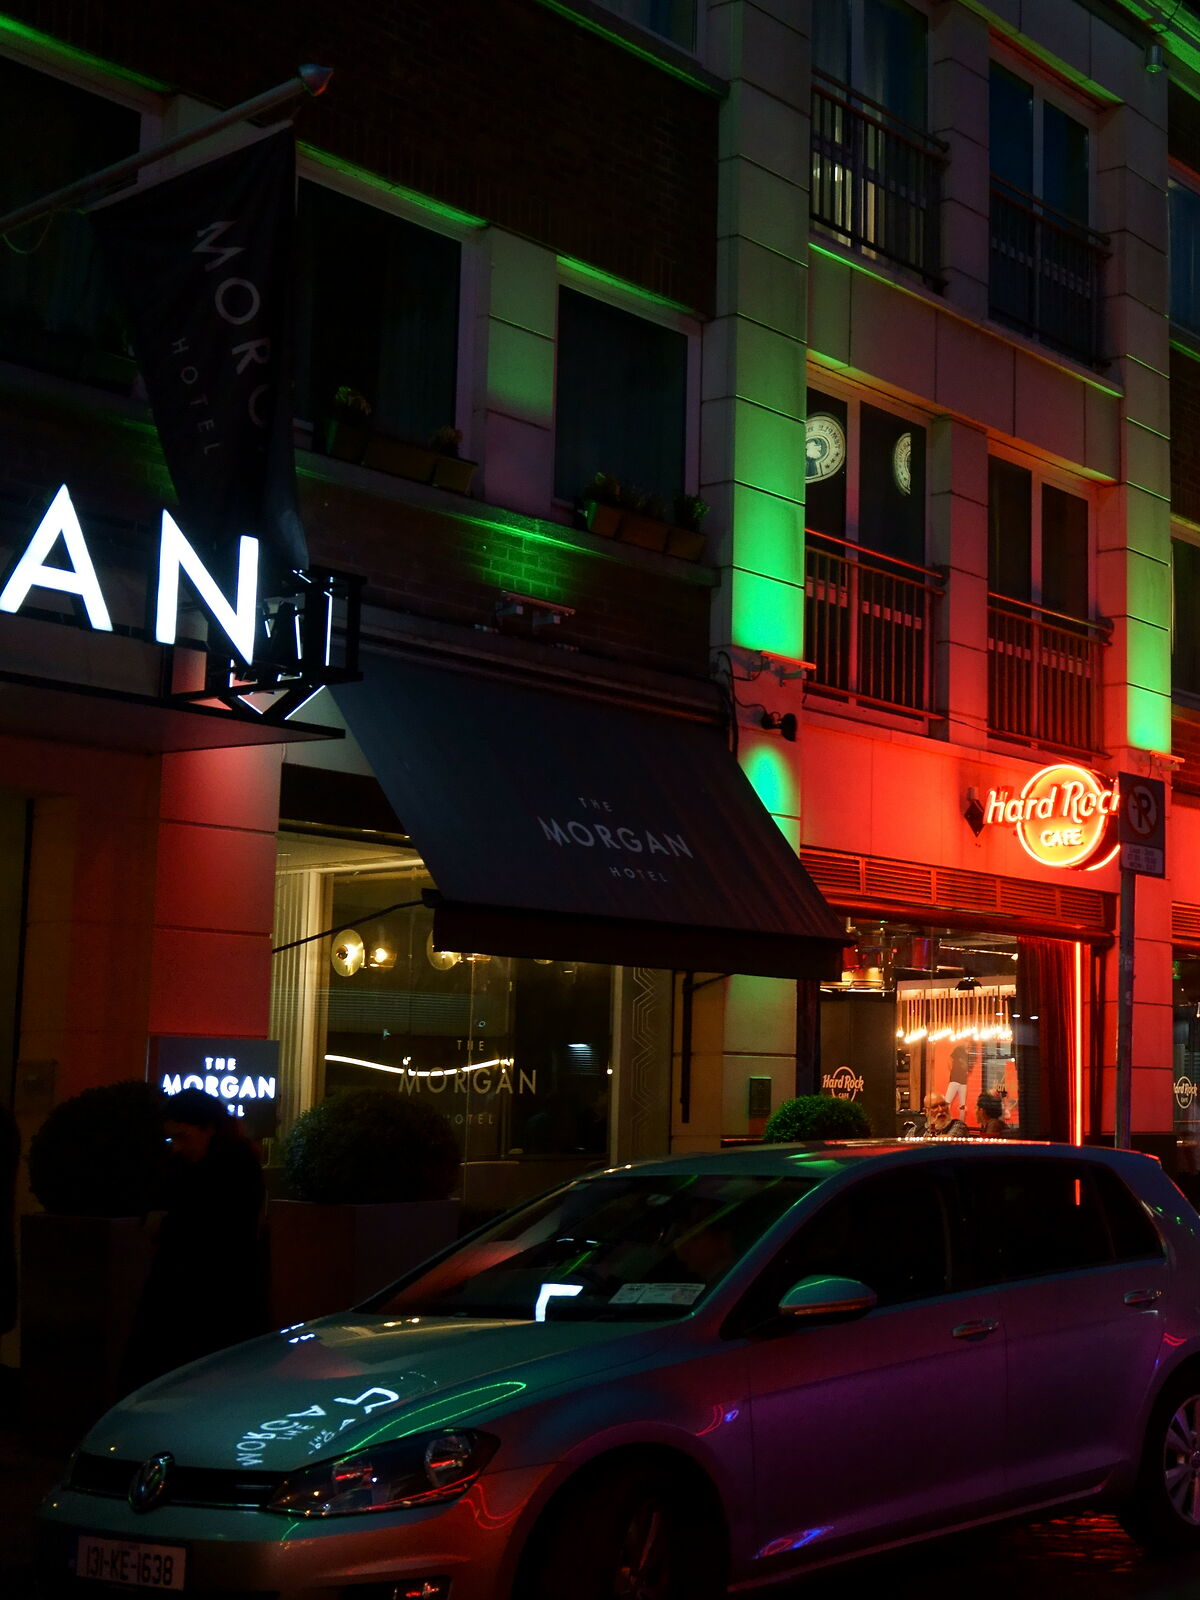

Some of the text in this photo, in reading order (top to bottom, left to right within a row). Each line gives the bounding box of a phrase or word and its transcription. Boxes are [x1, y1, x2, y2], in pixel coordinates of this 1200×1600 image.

[170, 336, 222, 456] HOTEL
[576, 796, 613, 813] THE
[983, 786, 1058, 824] Hard
[537, 815, 694, 859] MORGAN
[1040, 828, 1083, 847] CAFE
[608, 865, 668, 883] HOTEL
[457, 1040, 485, 1051] THE
[204, 1056, 237, 1071] THE
[162, 1073, 276, 1099] MORGAN
[398, 1066, 537, 1097] MORGAN
[822, 1074, 865, 1092] Hard Rock
